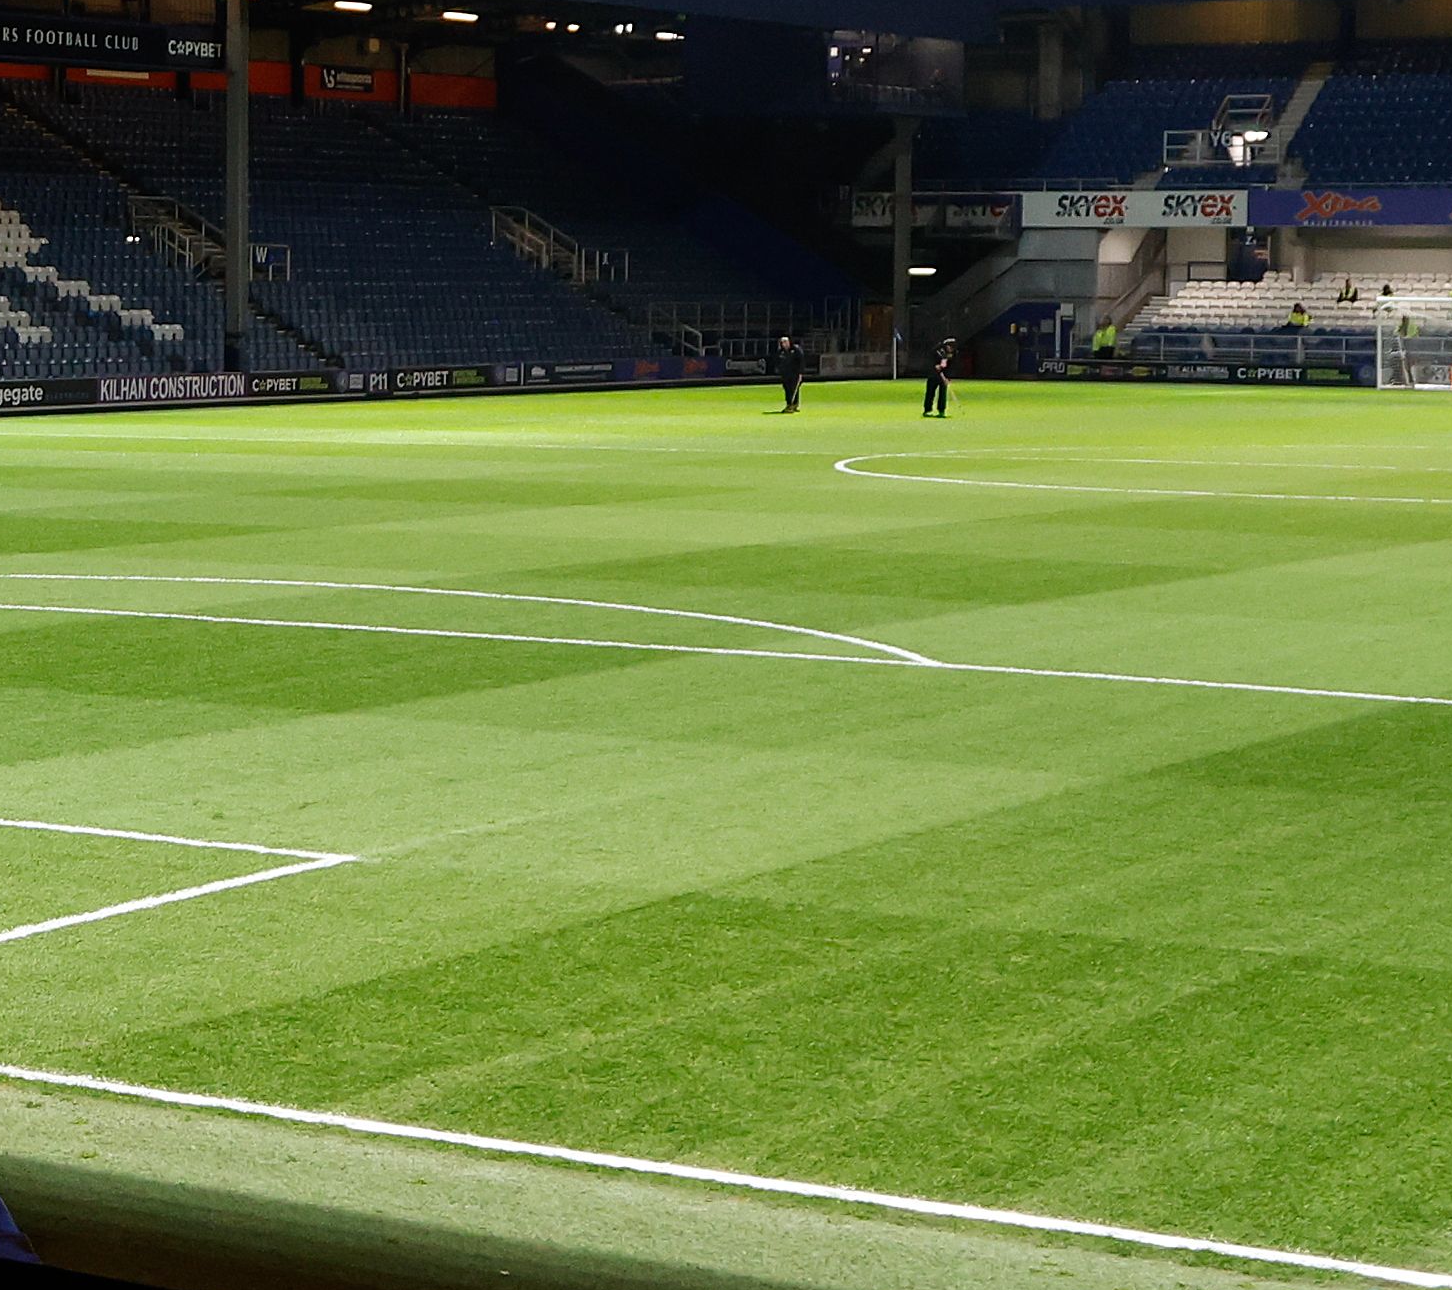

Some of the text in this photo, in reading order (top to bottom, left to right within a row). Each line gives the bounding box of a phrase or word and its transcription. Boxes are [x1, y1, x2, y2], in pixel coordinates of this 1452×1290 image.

[26, 28, 98, 49] FOOTBALL
[105, 33, 139, 51] CLUB
[256, 246, 268, 263] W
[100, 377, 146, 401] KILHAN
[150, 375, 245, 399] CONSTRUCTION
[370, 373, 388, 391] P11
